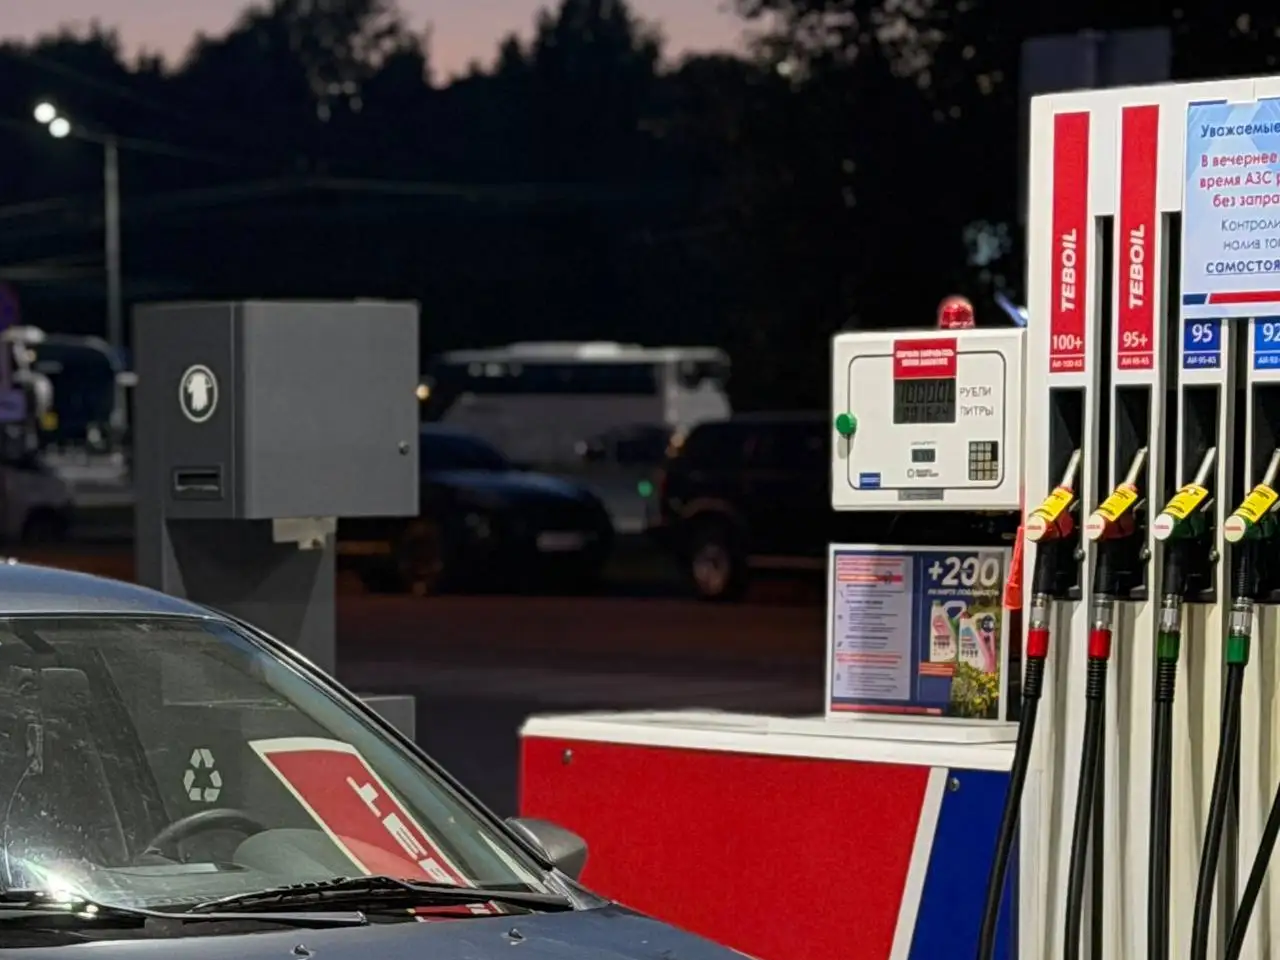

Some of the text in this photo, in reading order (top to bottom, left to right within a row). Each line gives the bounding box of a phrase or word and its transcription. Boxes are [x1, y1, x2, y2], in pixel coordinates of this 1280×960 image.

[1201, 122, 1280, 138] Уважаемые
[1201, 152, 1278, 168] В вечернее
[1200, 176, 1241, 190] время
[1245, 171, 1272, 186] АЗС
[1212, 194, 1236, 208] без
[1223, 238, 1280, 251] налив то
[1060, 227, 1077, 313] TEBOIL
[1128, 223, 1145, 309] TEBOIL
[1122, 331, 1148, 348] 95+
[1192, 323, 1213, 343] 95
[1051, 334, 1083, 350] 100+
[959, 386, 992, 398] РУБЛИ
[927, 556, 1000, 587] +200
